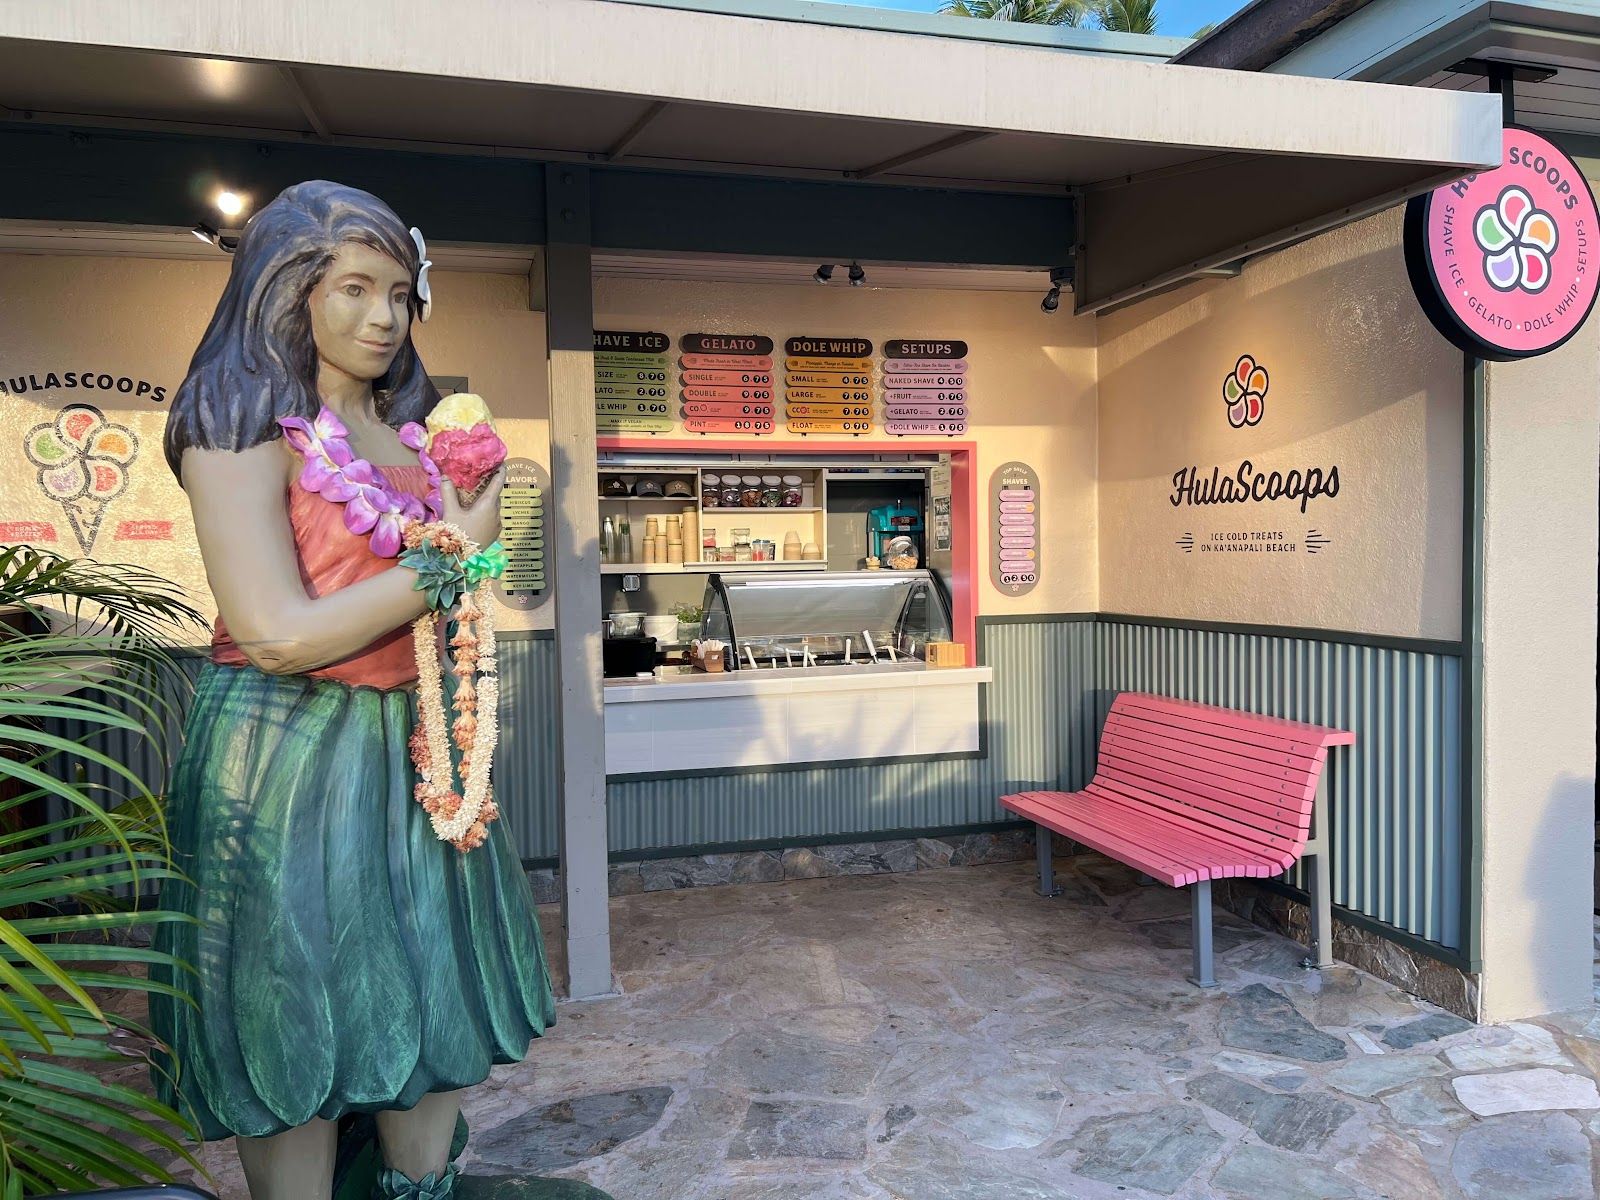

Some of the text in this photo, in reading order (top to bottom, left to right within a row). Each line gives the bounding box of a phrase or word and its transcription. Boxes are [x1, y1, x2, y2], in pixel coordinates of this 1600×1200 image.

[1443, 205, 1587, 332] SHAVE ICE GELATO DOLE WHIP SETUPS
[593, 335, 662, 349] HAVE ICE
[701, 338, 756, 350] GELATO
[793, 341, 866, 353] DOLE WHIP
[902, 344, 952, 354] SETUPS
[597, 371, 614, 379] SIZE
[637, 371, 666, 381] 8.75
[742, 374, 769, 383] 6.75
[595, 387, 614, 395] LATO
[637, 387, 666, 397] 2.75
[597, 403, 605, 411] LE
[638, 403, 667, 413] 1.75
[506, 463, 523, 471] HAVE
[1170, 460, 1340, 513] HulaScoops
[1211, 533, 1223, 541] ICE
[1251, 532, 1283, 540] TREATS
[1201, 544, 1211, 552] ON
[1266, 543, 1296, 552] BEACH
